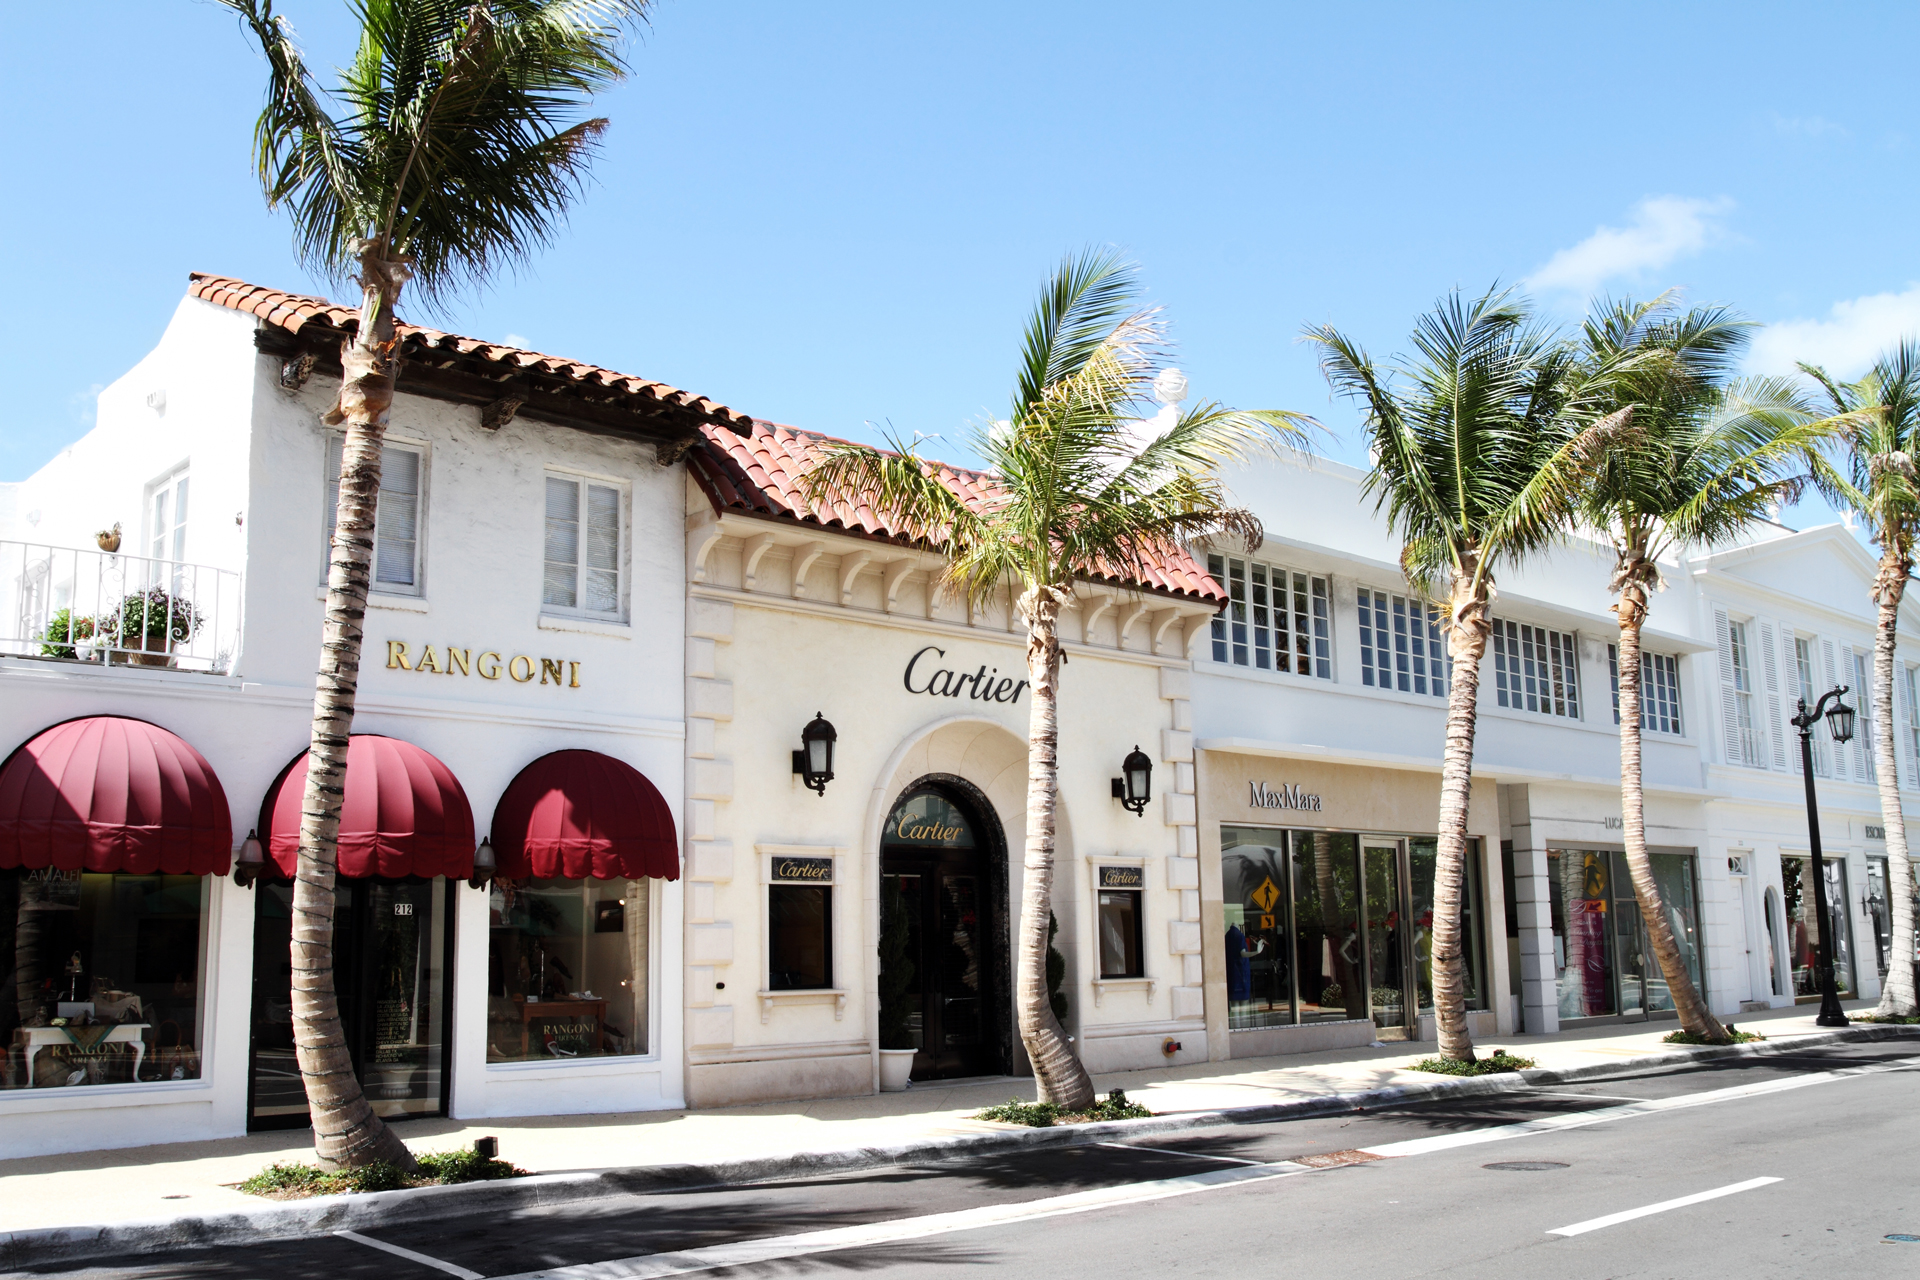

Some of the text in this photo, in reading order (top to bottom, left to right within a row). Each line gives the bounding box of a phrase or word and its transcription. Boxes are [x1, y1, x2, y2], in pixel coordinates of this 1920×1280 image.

[386, 640, 581, 688] RANGONI
[903, 646, 1031, 704] Cartier
[1249, 780, 1322, 812] MaxMara
[897, 813, 964, 841] Cartier
[28, 869, 80, 881] AMALFI
[779, 861, 828, 878] Cartier
[1105, 870, 1139, 884] Cartier
[395, 904, 412, 915] 212
[543, 1023, 595, 1035] RANGONI
[52, 1042, 126, 1057] RANGONI
